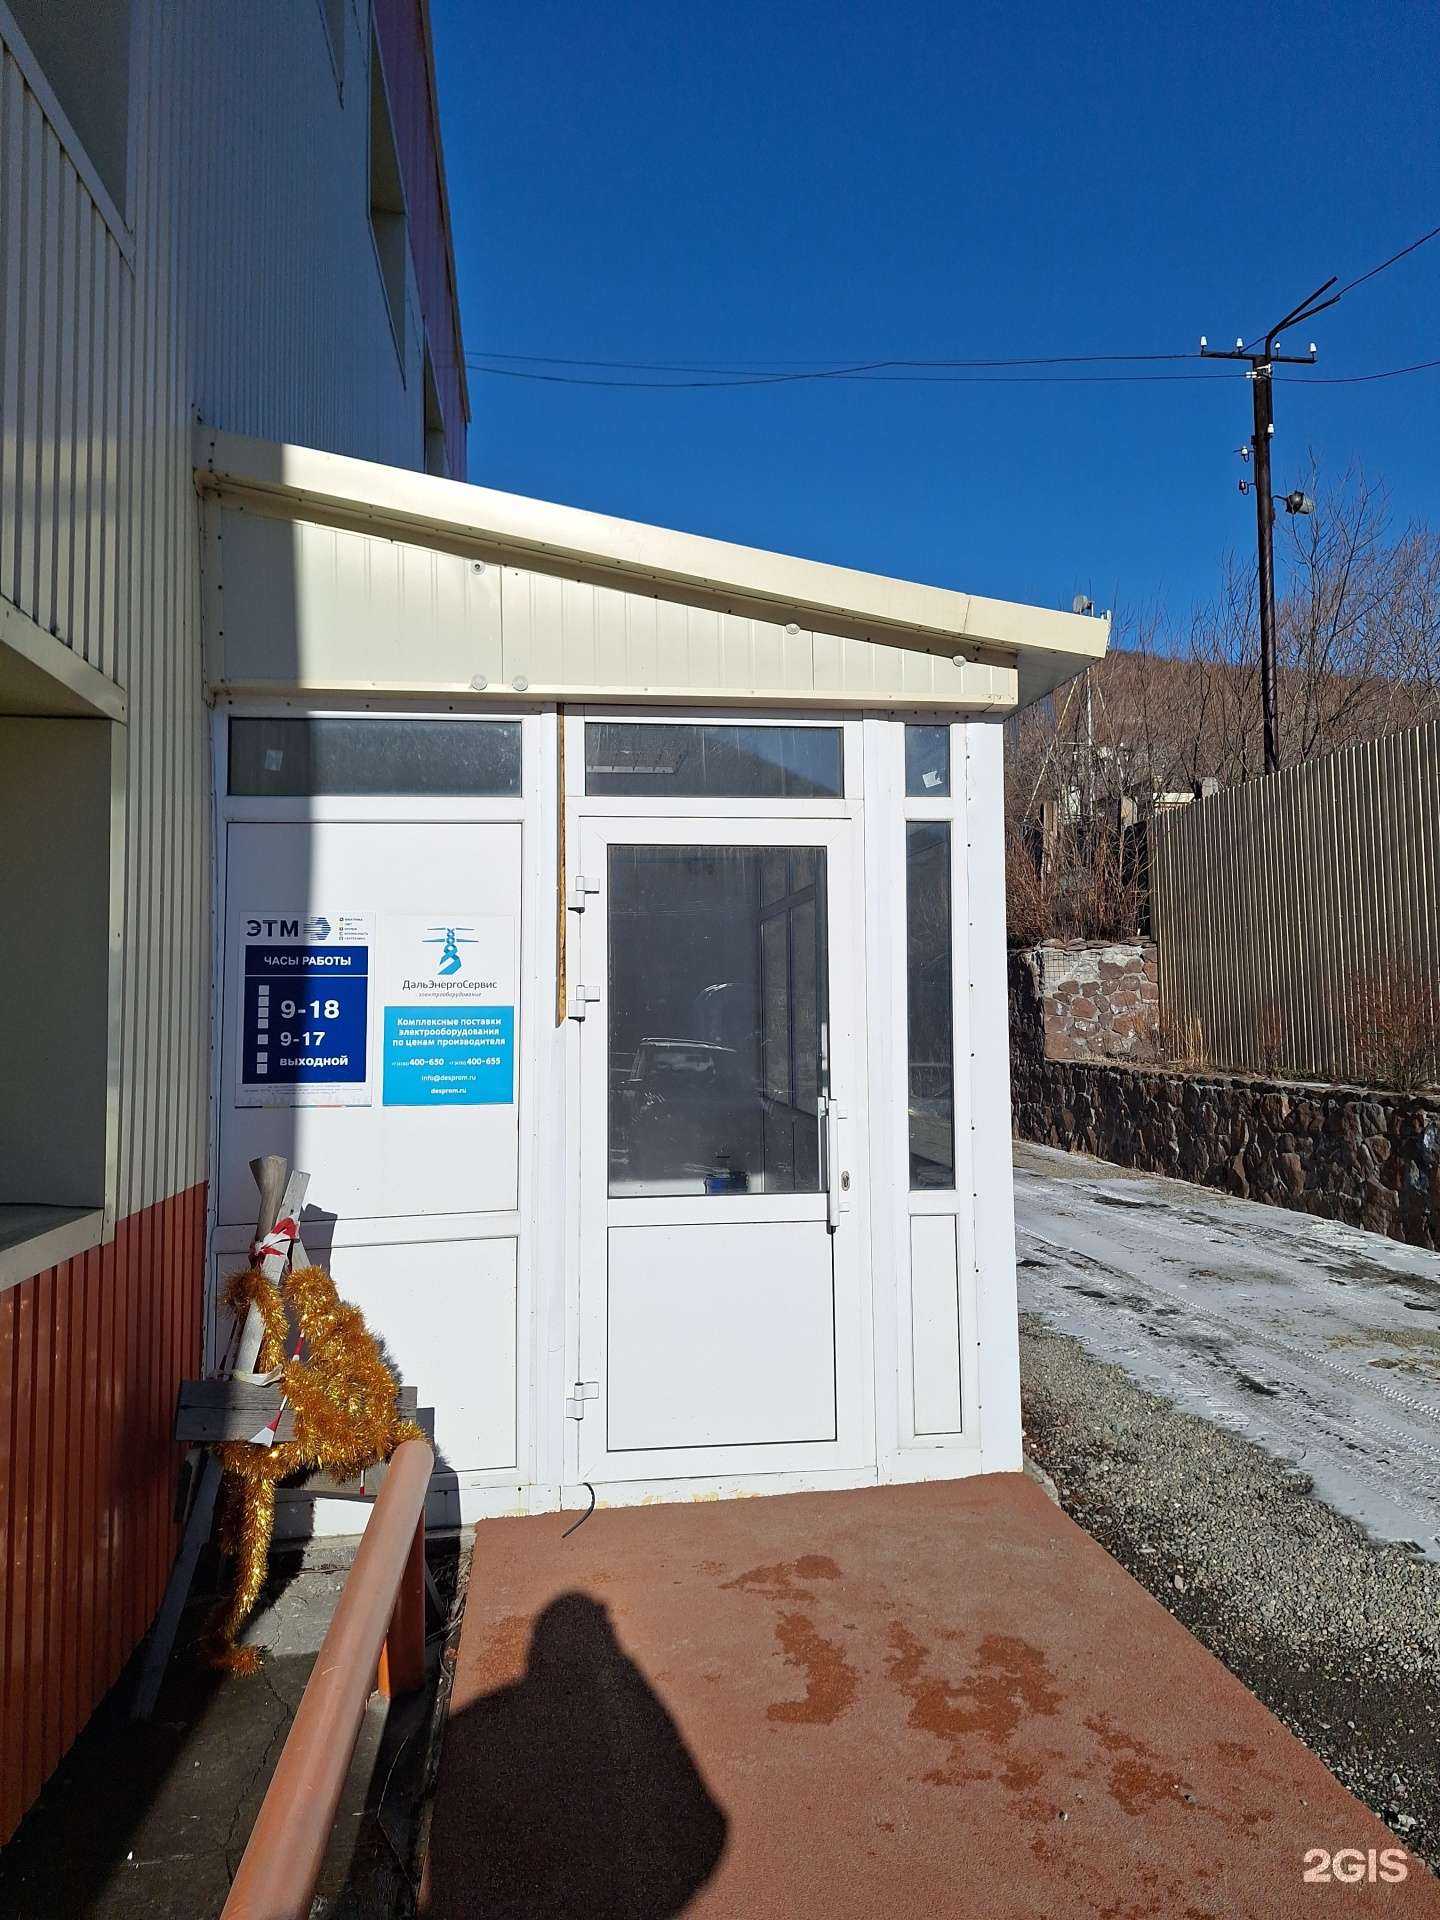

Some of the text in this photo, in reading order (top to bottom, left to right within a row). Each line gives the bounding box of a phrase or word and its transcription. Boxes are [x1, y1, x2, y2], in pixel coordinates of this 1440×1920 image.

[246, 920, 299, 937] ЭТМ
[264, 956, 351, 966] ЧАСЫ РАБОТЫ
[403, 980, 498, 990] ДальЭнергоСервис
[281, 1000, 340, 1018] 9-18
[398, 1018, 458, 1026] Комплексные
[399, 1028, 499, 1037] электрооборудования
[280, 1032, 325, 1046] 9-17
[437, 1038, 505, 1047] производителя
[280, 1055, 348, 1067] выходной
